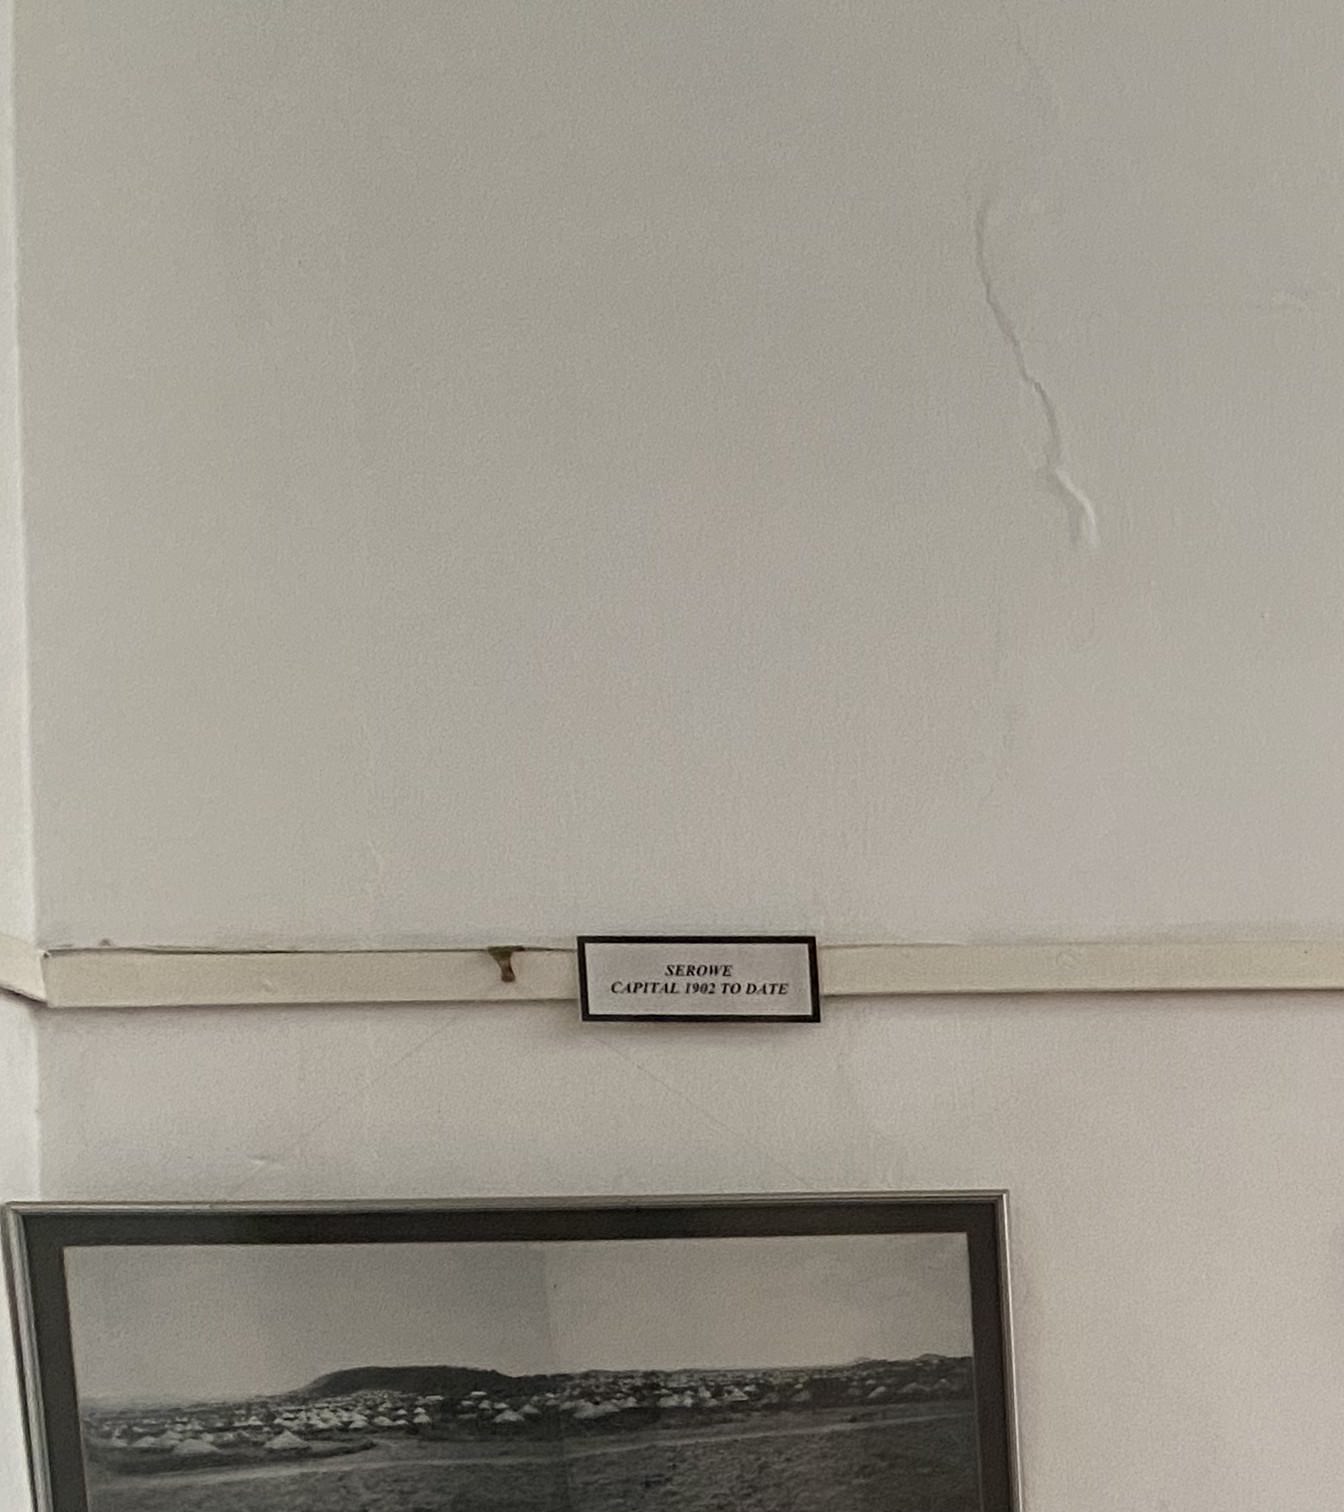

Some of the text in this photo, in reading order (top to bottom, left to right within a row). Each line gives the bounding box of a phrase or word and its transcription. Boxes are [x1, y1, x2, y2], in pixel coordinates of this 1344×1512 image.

[664, 964, 733, 977] SEROWE
[610, 981, 789, 995] CAPITAL 1902 TO DATE
